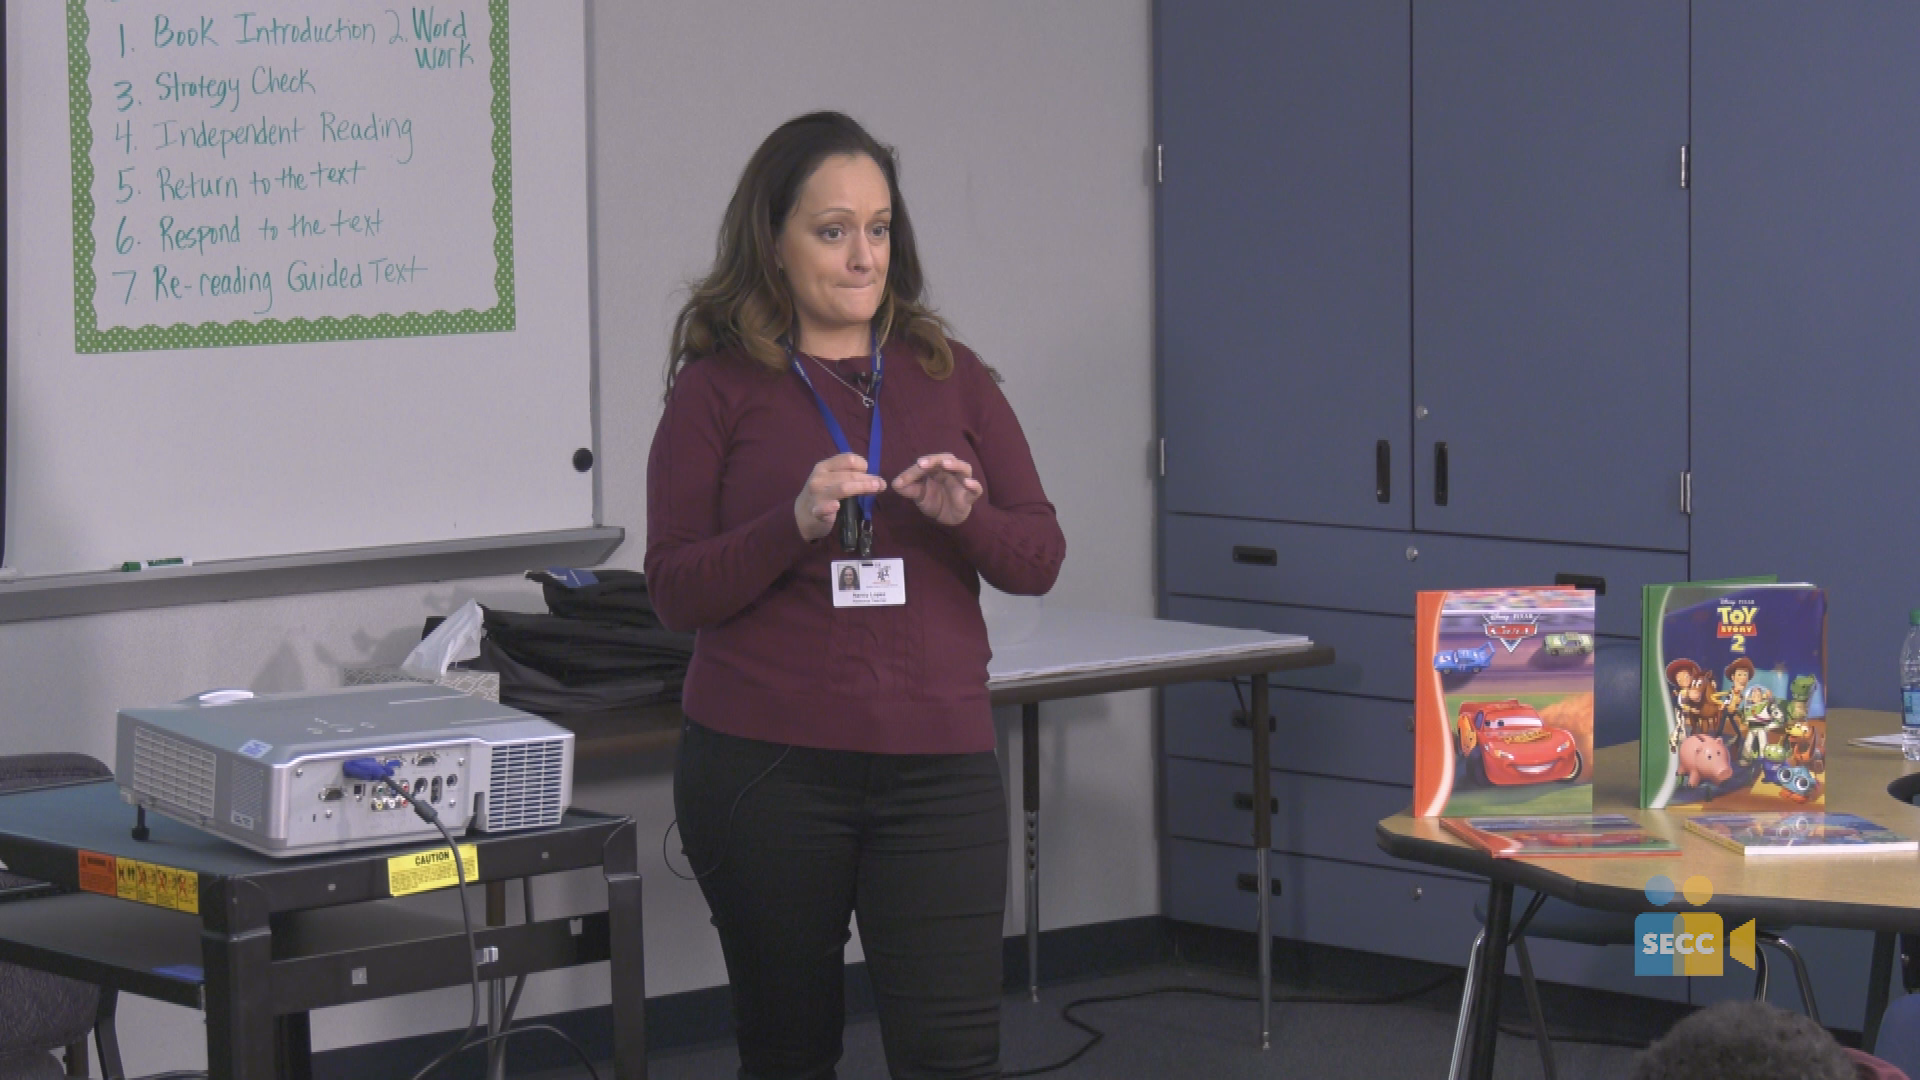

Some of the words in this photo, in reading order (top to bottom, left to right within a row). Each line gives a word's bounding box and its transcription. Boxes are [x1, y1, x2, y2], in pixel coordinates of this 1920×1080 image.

[119, 23, 136, 58] 1.
[154, 14, 219, 48] Book
[233, 12, 376, 45] Introduction
[384, 10, 409, 43] 2.
[412, 6, 467, 42] Word
[114, 80, 142, 112] 3.
[155, 70, 240, 113] Strategy
[251, 65, 317, 95] Check
[114, 118, 138, 154] 4.
[153, 115, 305, 158] Independent
[319, 111, 414, 165] Reading
[115, 166, 142, 204] 5.
[156, 166, 239, 202] Return
[249, 171, 271, 196] to
[274, 165, 309, 192] the
[310, 159, 367, 186] text
[115, 215, 142, 255] 6.
[159, 214, 241, 257] Respond
[258, 217, 279, 242] to
[287, 213, 326, 238] the
[329, 208, 384, 238] text
[152, 263, 273, 315] Re-reading
[287, 257, 364, 293] Guided
[368, 255, 429, 285] Text
[1716, 605, 1759, 625] TOY
[1720, 624, 1753, 633] STORY
[1730, 633, 1746, 653] 2
[414, 851, 450, 867] CAUTION
